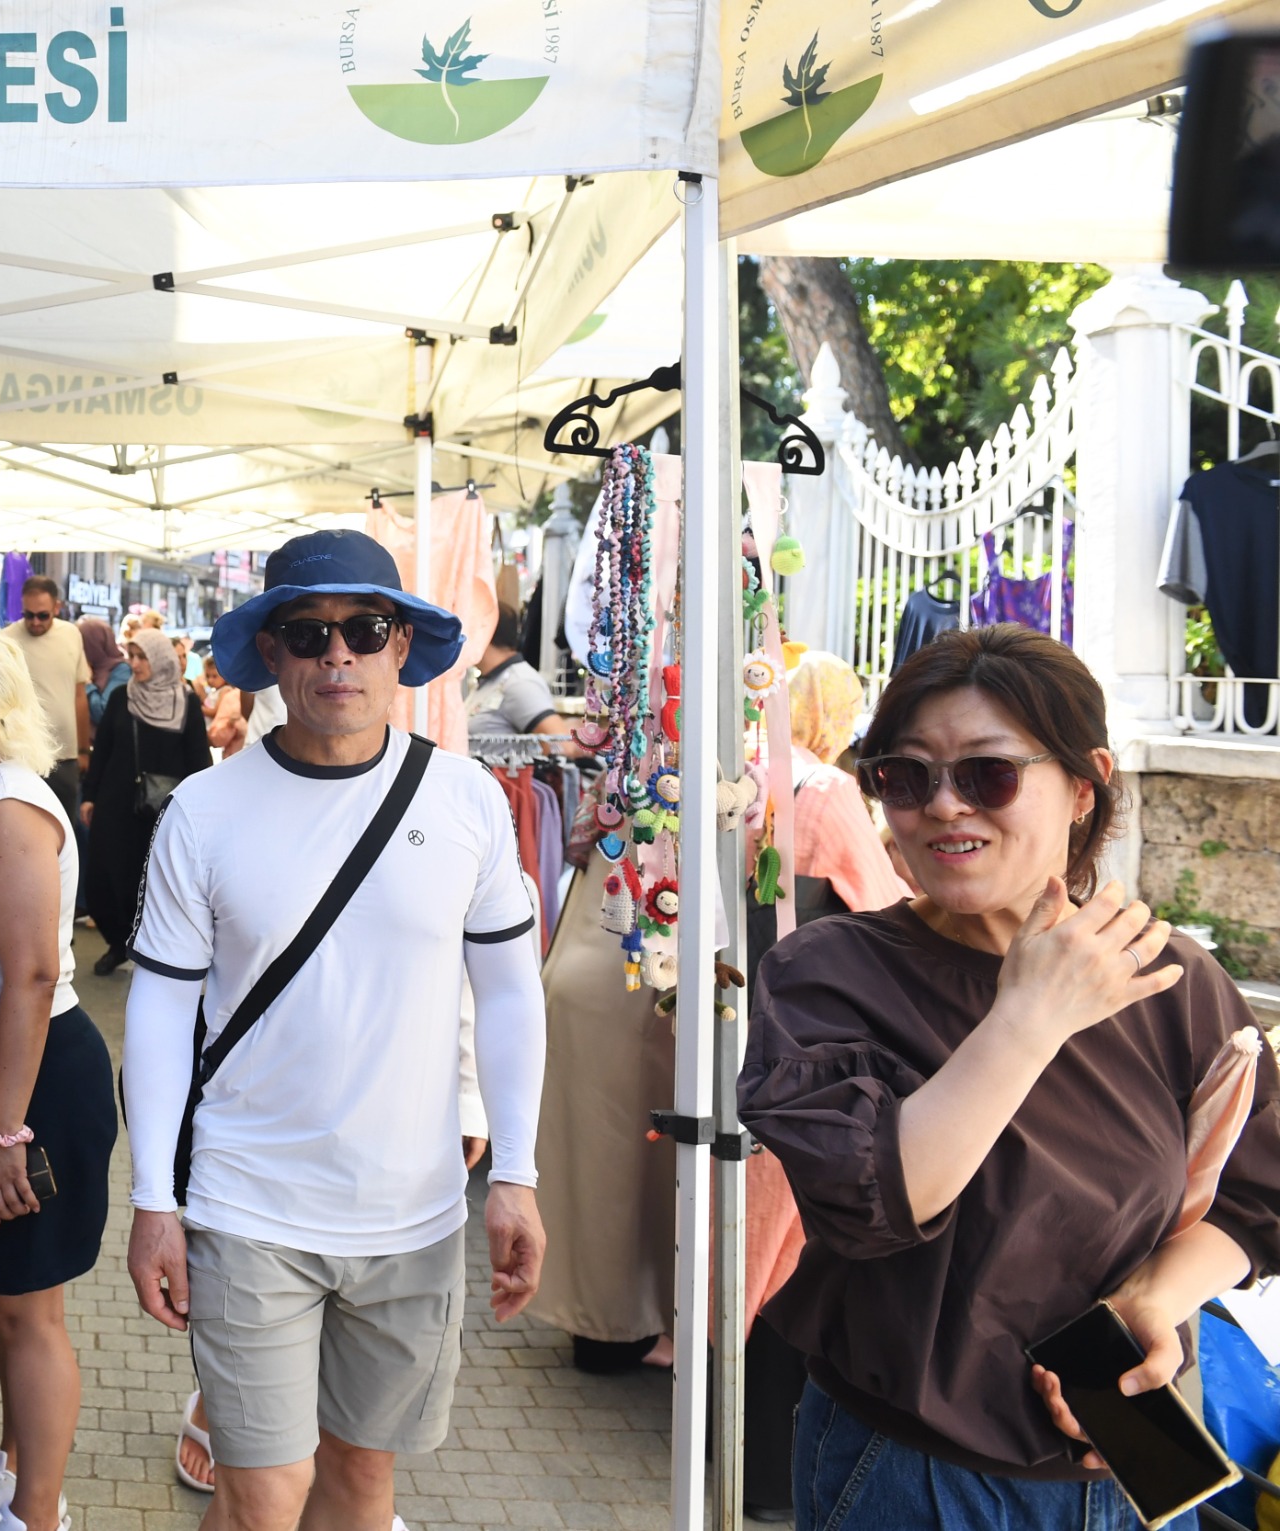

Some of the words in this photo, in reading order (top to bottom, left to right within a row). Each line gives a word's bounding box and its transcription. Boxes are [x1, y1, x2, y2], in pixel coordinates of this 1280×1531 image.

[339, 7, 361, 74] BURSA
[543, 26, 561, 64] 1987
[871, 12, 884, 57] 1987
[731, 50, 747, 120] BURSA
